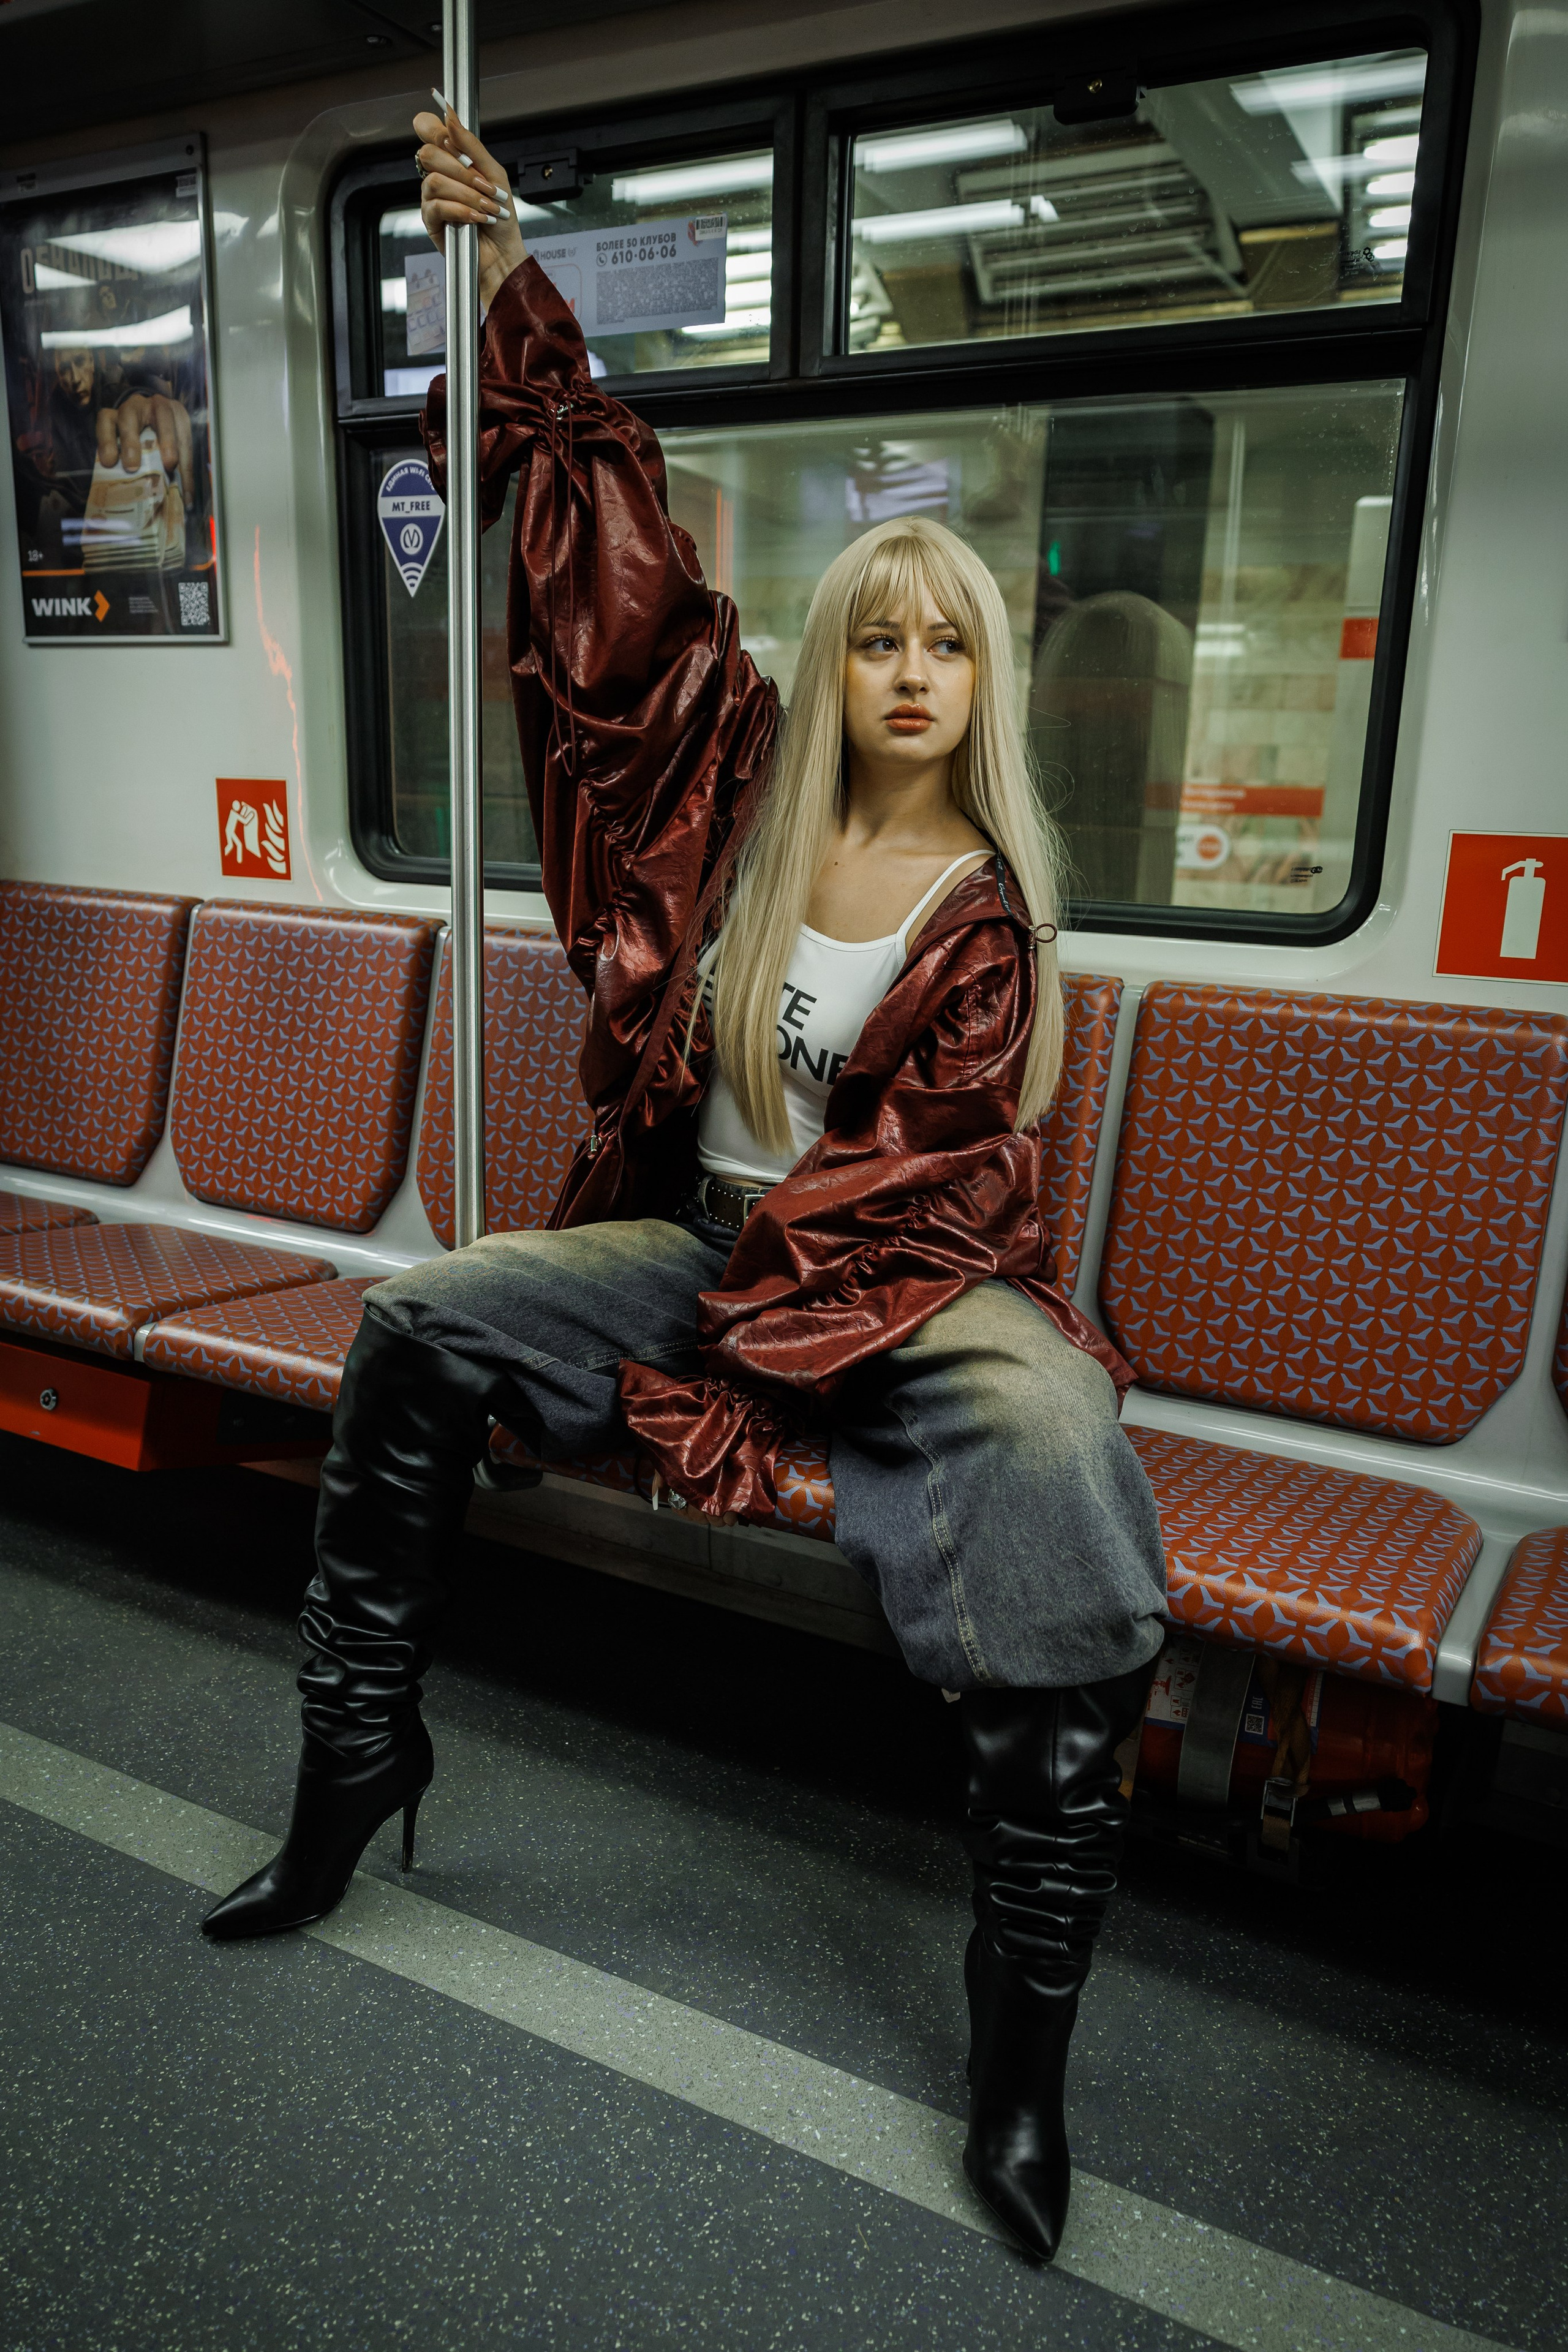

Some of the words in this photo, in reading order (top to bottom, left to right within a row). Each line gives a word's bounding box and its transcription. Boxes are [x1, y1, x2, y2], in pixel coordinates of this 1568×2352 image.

[597, 239, 624, 252] БОЛЕЕ
[627, 238, 637, 247] 50
[640, 232, 676, 246] КЛУБОВ
[540, 248, 566, 260] HOUSE
[392, 500, 431, 513] MT_FREE
[27, 549, 44, 562] 18+
[31, 597, 93, 617] WINK
